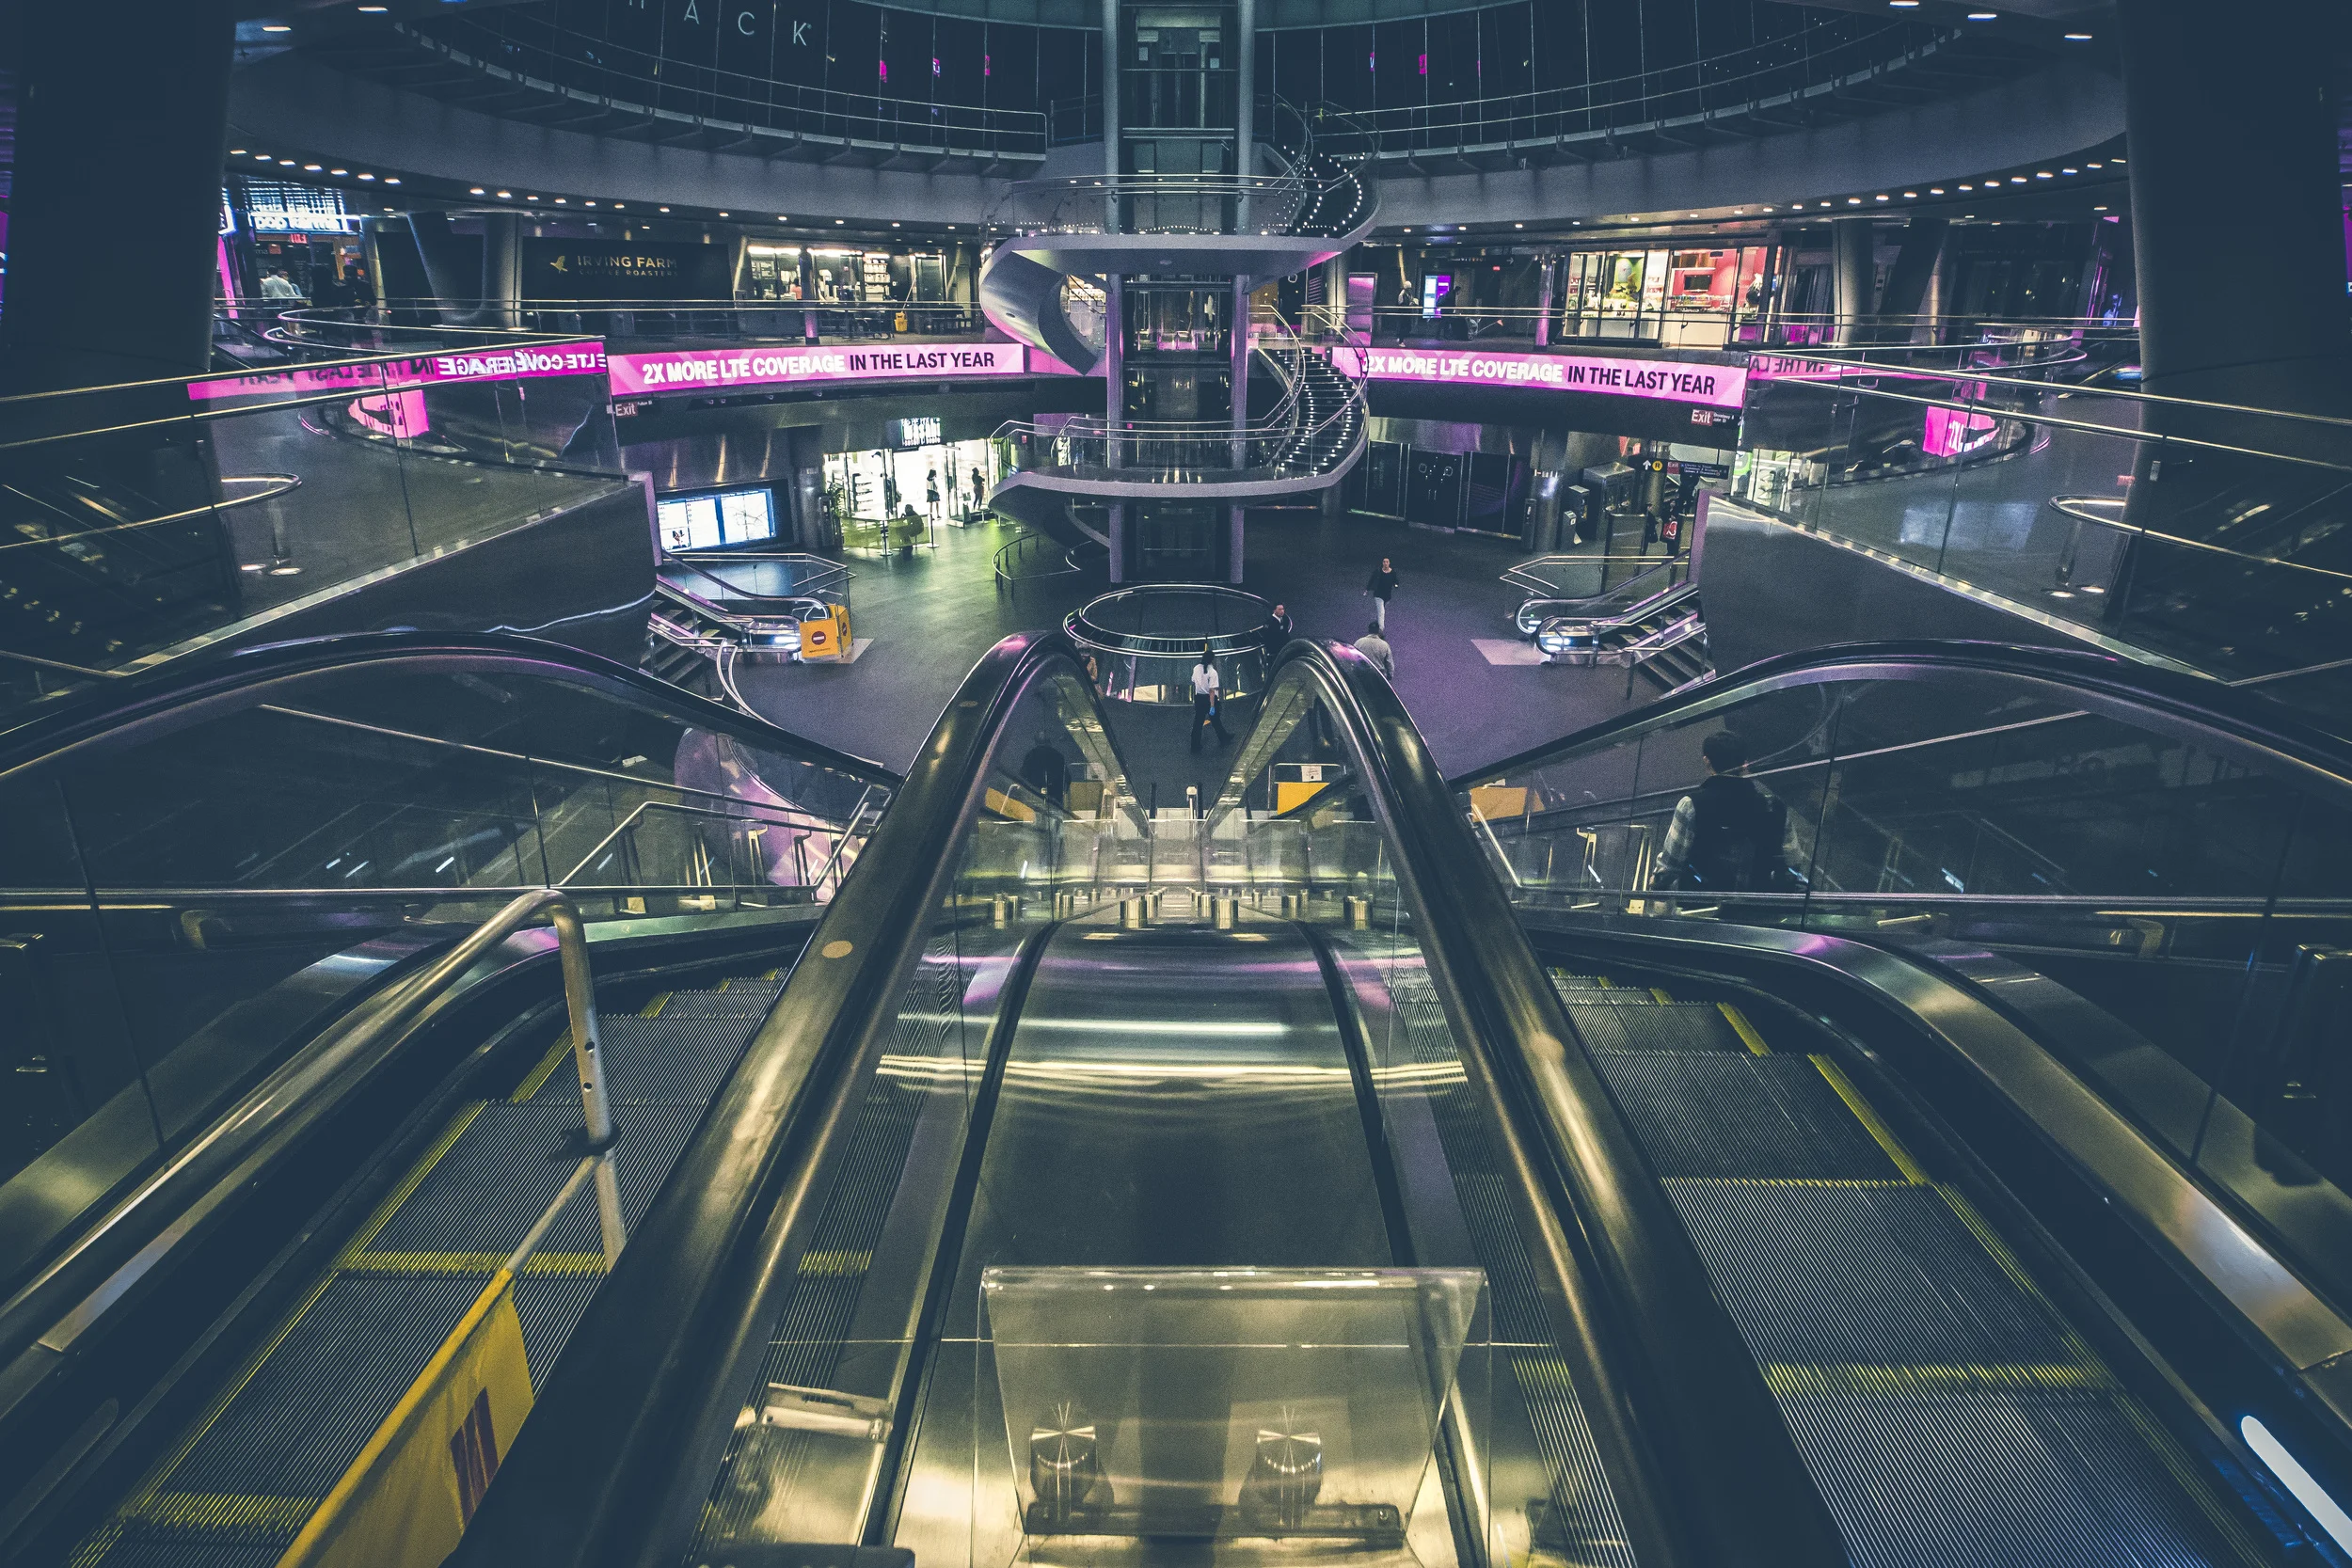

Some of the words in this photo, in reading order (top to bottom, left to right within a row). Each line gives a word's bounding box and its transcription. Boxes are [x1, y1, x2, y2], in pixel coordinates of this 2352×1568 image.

[629, 0, 806, 46] ACK
[577, 255, 632, 268] IRVING
[636, 256, 677, 268] FARM
[643, 363, 665, 384] 2X
[666, 359, 718, 382] MORE
[720, 356, 751, 378] LTE
[753, 355, 845, 376] COVERAGE
[850, 354, 866, 371] IN
[870, 353, 903, 370] THE
[906, 352, 946, 369] LAST
[950, 352, 994, 368] YEAR
[1363, 356, 1386, 372] 2X
[1388, 356, 1438, 375] MORE
[1439, 357, 1470, 376] LTE
[1471, 359, 1564, 383] COVERAGE
[1567, 365, 1585, 383] IN
[1589, 366, 1622, 387] THE
[1625, 369, 1668, 390] LAST
[1671, 372, 1715, 395] YEAR
[614, 403, 636, 416] Exit
[1692, 409, 1711, 424] Exit
